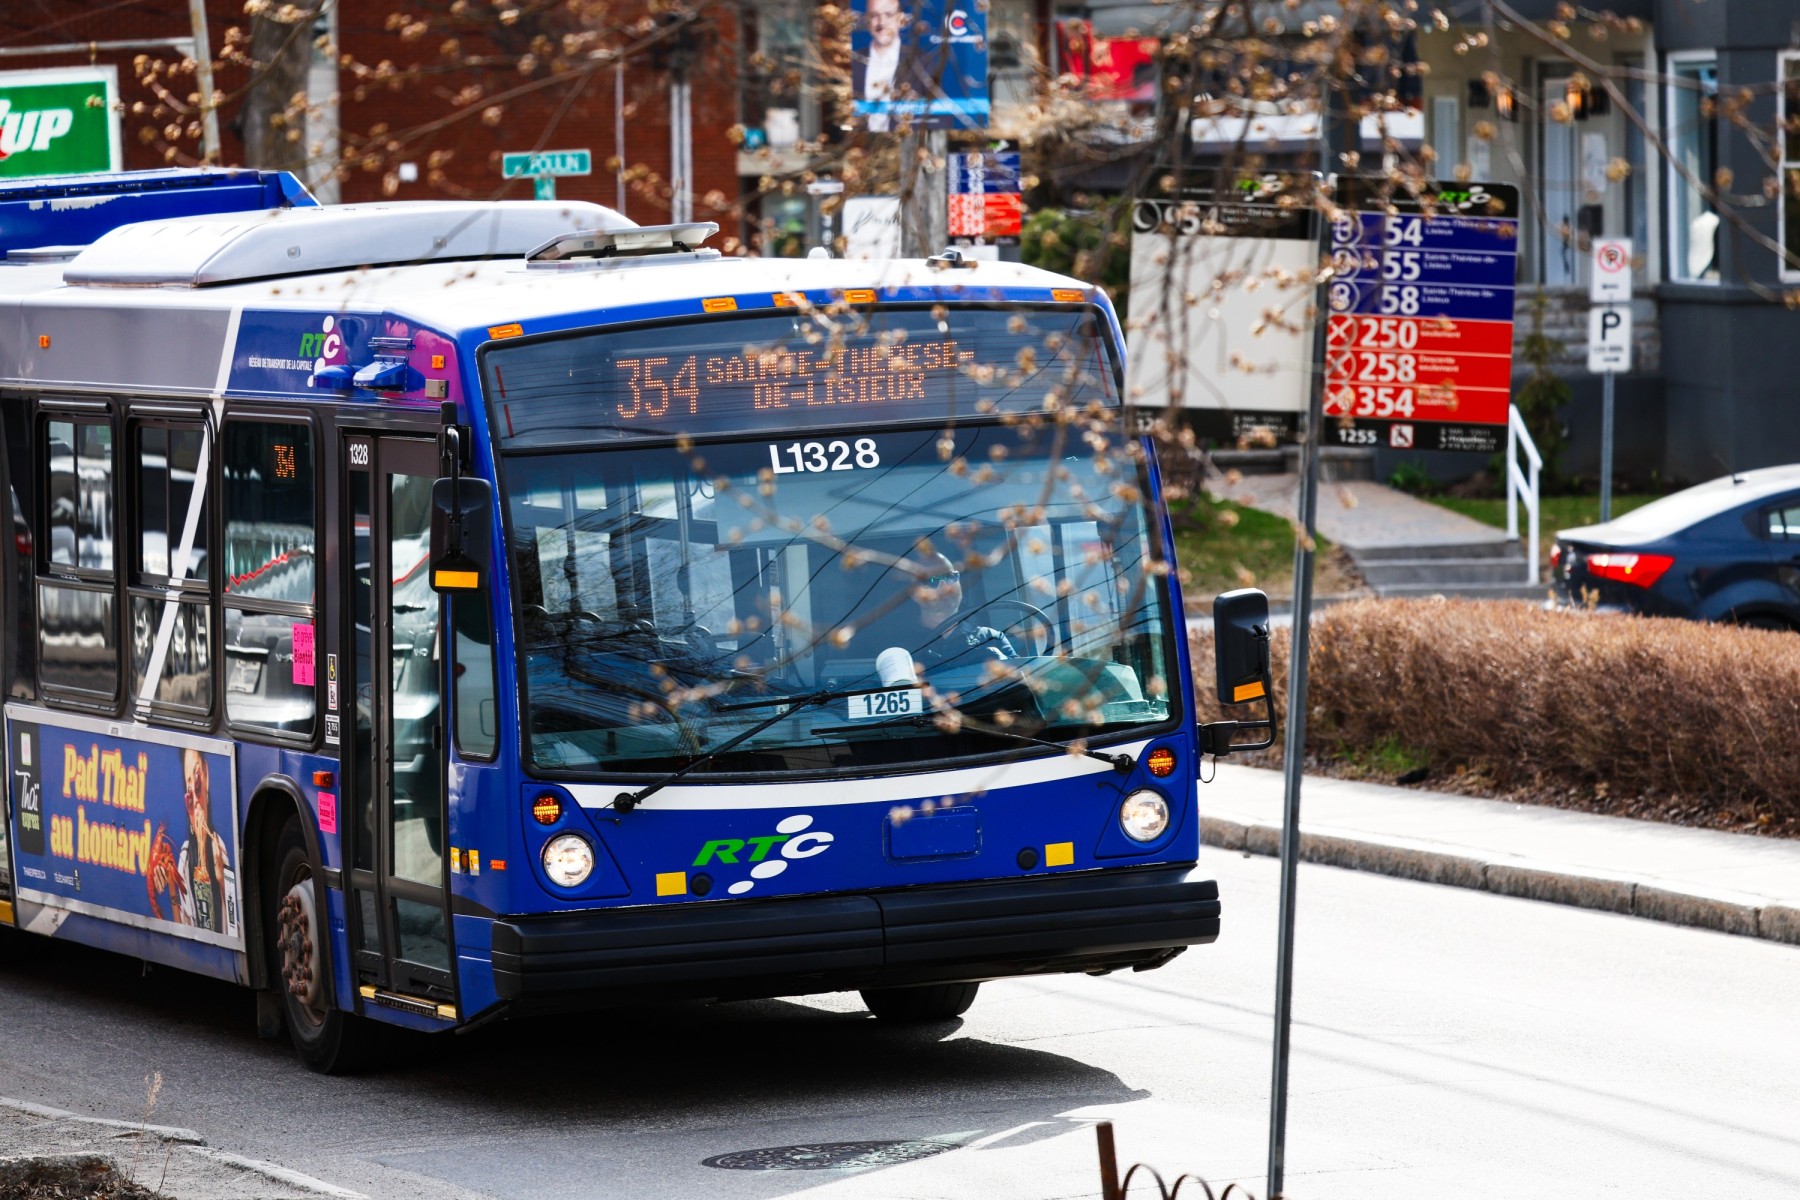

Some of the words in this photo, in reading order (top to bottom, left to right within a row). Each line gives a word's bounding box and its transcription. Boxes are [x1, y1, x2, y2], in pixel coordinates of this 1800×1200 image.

[1384, 217, 1423, 247] 54
[1382, 252, 1421, 281] 55
[1380, 285, 1420, 315] 58
[1360, 318, 1418, 349] 250
[1601, 311, 1621, 341] P
[298, 332, 340, 359] RTC
[1358, 352, 1416, 383] 258
[616, 355, 700, 418] 354
[754, 373, 925, 409] DE-LISIEUX
[1356, 386, 1415, 417] 354
[1338, 429, 1377, 444] 1255
[274, 445, 295, 478] 354
[350, 443, 369, 465] 1328
[768, 438, 880, 474] L1328
[863, 691, 910, 715] 1265
[15, 769, 39, 811] Thaï
[63, 743, 99, 802] Pad
[101, 748, 148, 813] Thaï
[51, 814, 74, 859] au
[77, 804, 152, 876] homard
[691, 831, 834, 866] RTC
